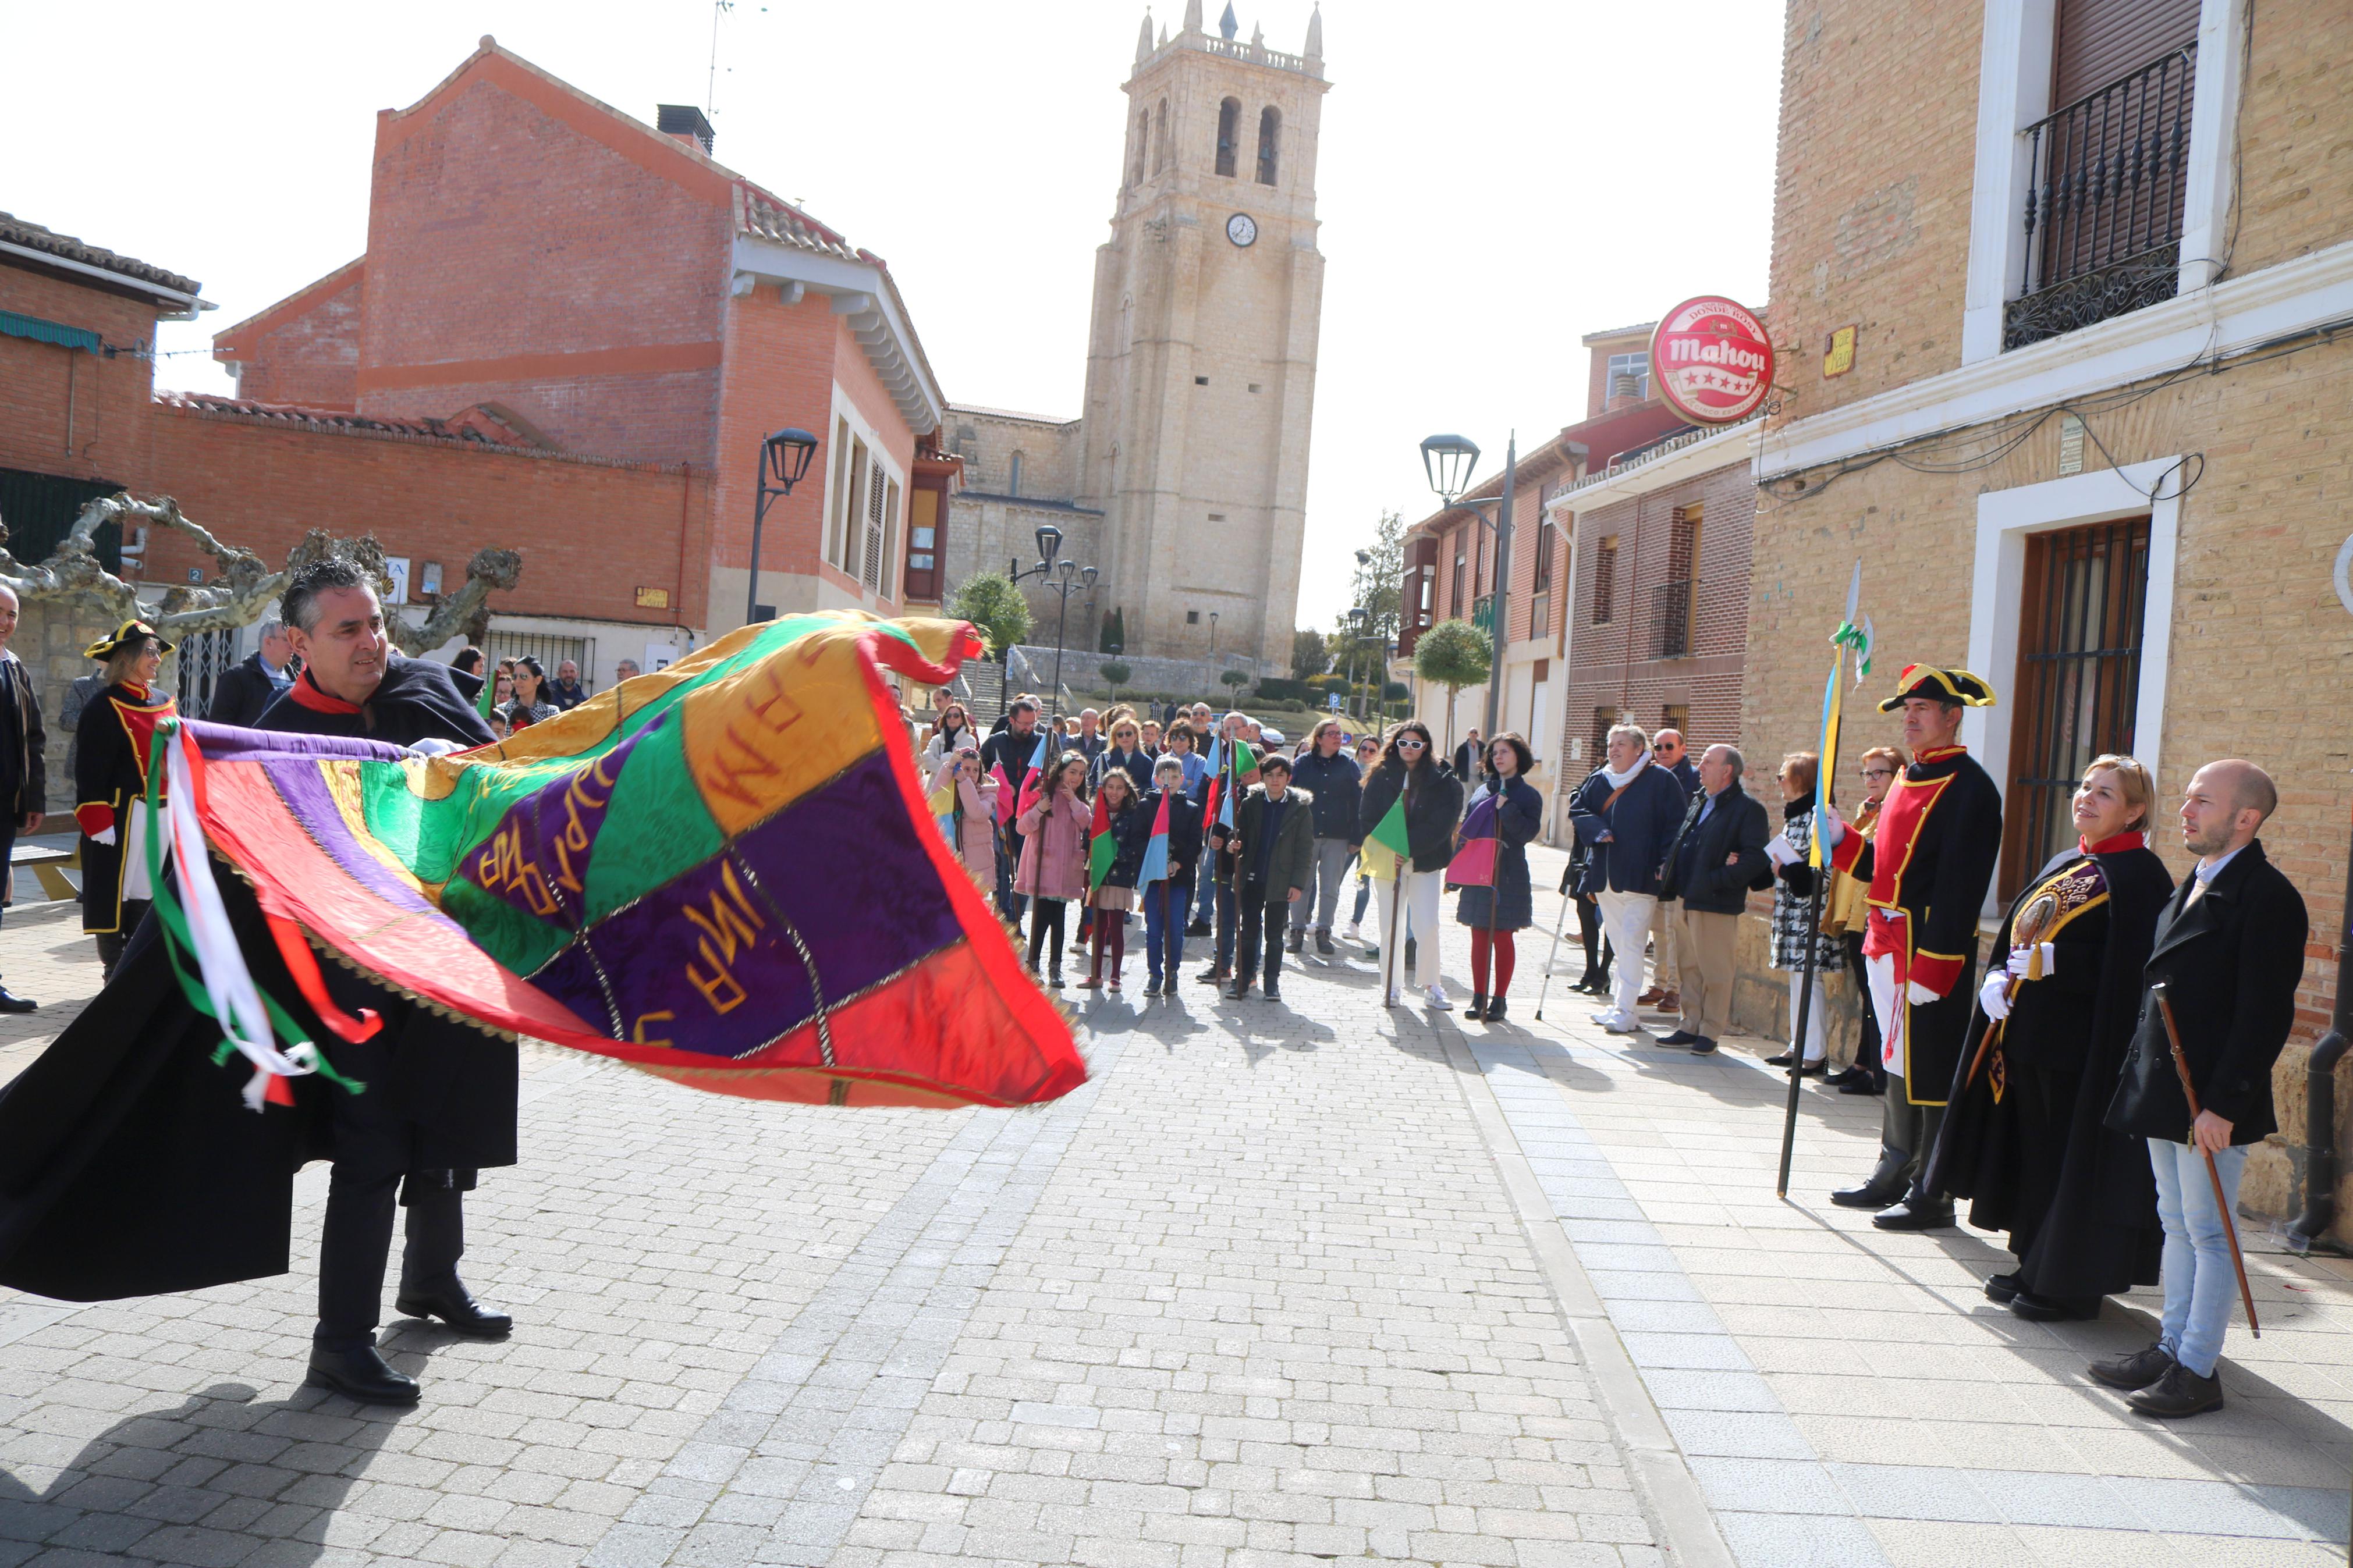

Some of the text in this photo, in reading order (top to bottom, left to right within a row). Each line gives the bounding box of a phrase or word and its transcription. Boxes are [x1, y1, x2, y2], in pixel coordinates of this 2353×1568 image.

[1689, 305, 1730, 319] DONDE
[192, 570, 200, 579] 2
[1332, 695, 1339, 706] P
